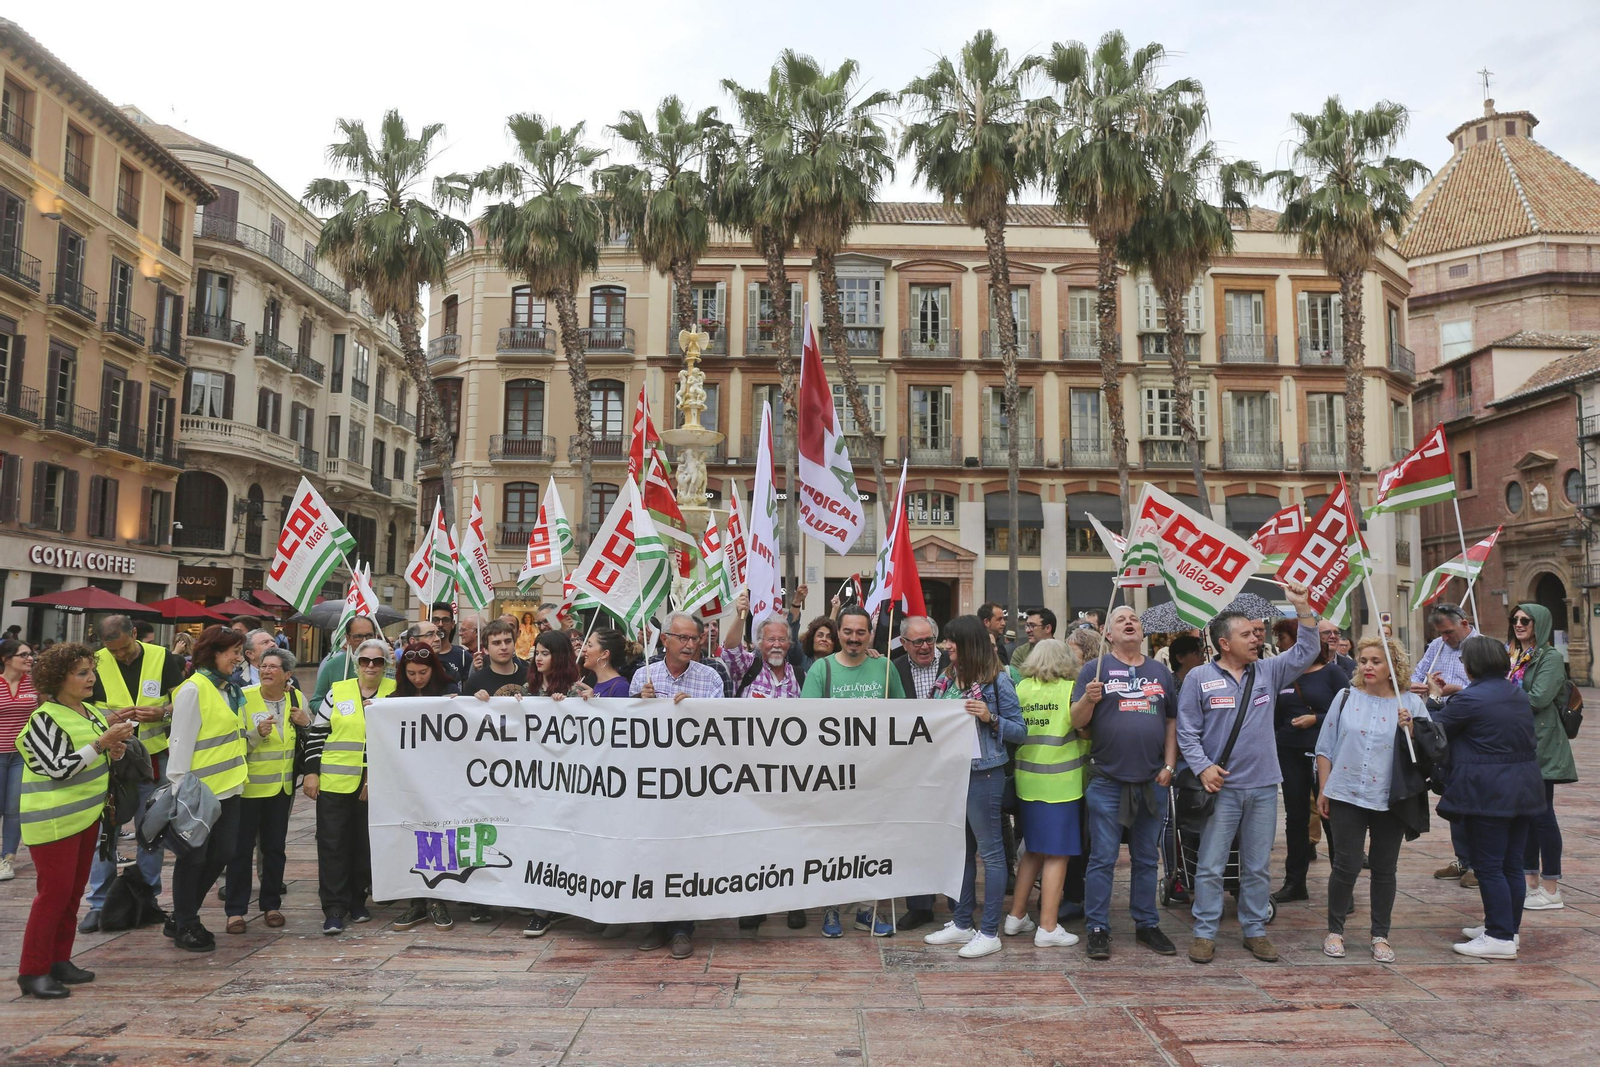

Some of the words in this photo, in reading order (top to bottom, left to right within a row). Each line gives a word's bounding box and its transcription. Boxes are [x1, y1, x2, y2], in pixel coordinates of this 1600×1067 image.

[1141, 495, 1251, 584] CCOO
[30, 545, 83, 569] COSTA
[85, 552, 136, 574] COFFEE
[472, 547, 494, 591] Málaga
[1176, 558, 1226, 596] Málaga
[401, 714, 468, 749] ¡¡NO
[475, 715, 517, 742] AL
[525, 715, 604, 746] PACTO
[611, 717, 807, 748] EDUCATIVO
[819, 717, 876, 746] SIN
[890, 717, 932, 745] LA
[1023, 717, 1050, 727] Málaga
[467, 759, 626, 798] COMUNIDAD
[638, 764, 855, 799] EDUCATIVA!!
[442, 820, 452, 828] por
[414, 823, 498, 871] MIEP
[525, 861, 586, 896] Málaga
[590, 879, 626, 902] por
[632, 874, 653, 899] la
[665, 864, 793, 897] Educación
[803, 855, 892, 884] Pública
